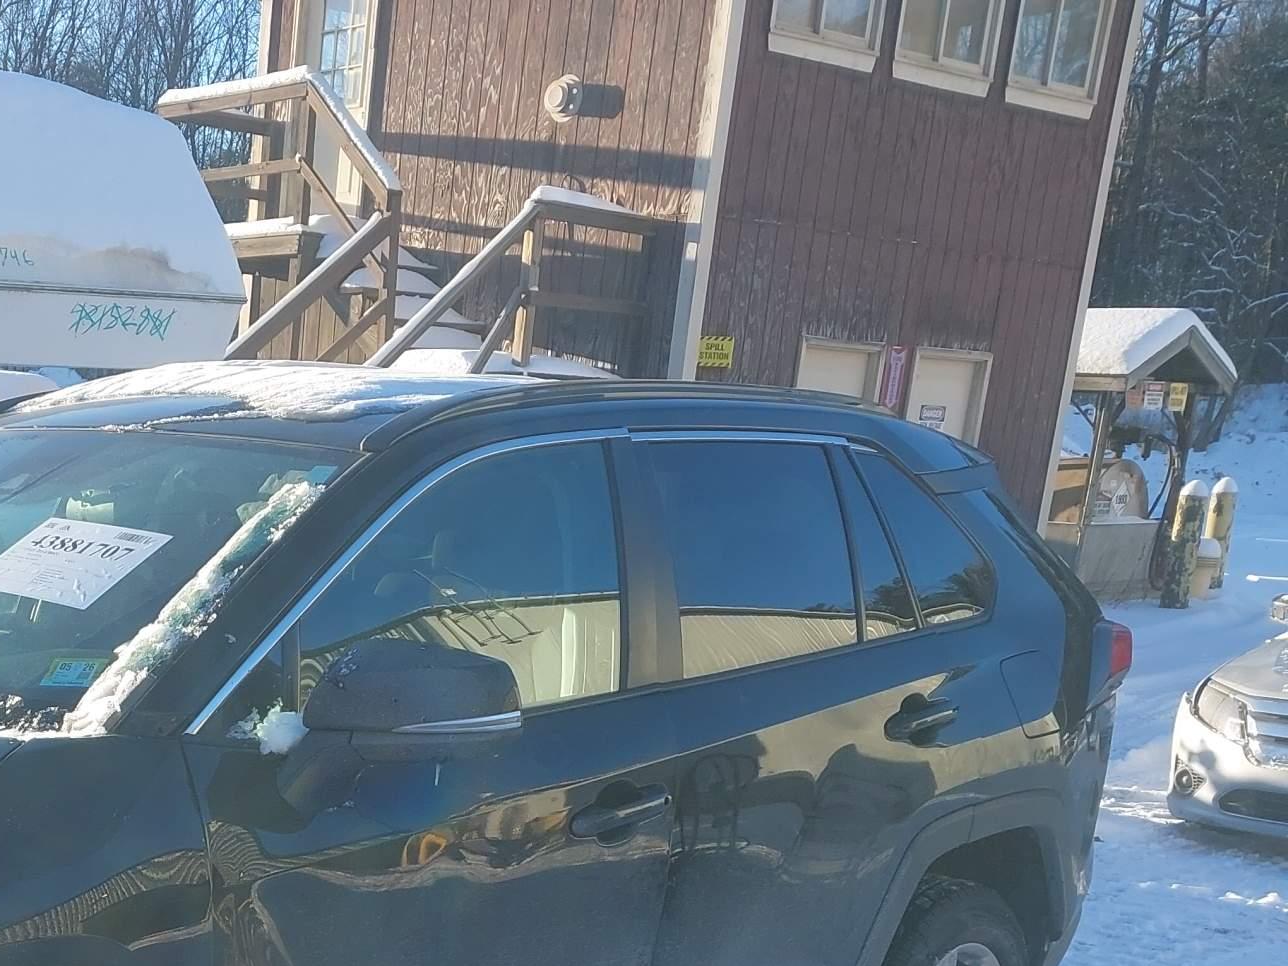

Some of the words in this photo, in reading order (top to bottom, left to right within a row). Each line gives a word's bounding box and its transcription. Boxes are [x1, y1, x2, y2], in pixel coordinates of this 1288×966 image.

[705, 343, 724, 351] SPILL
[699, 352, 729, 360] STATION
[31, 534, 135, 562] 43881707
